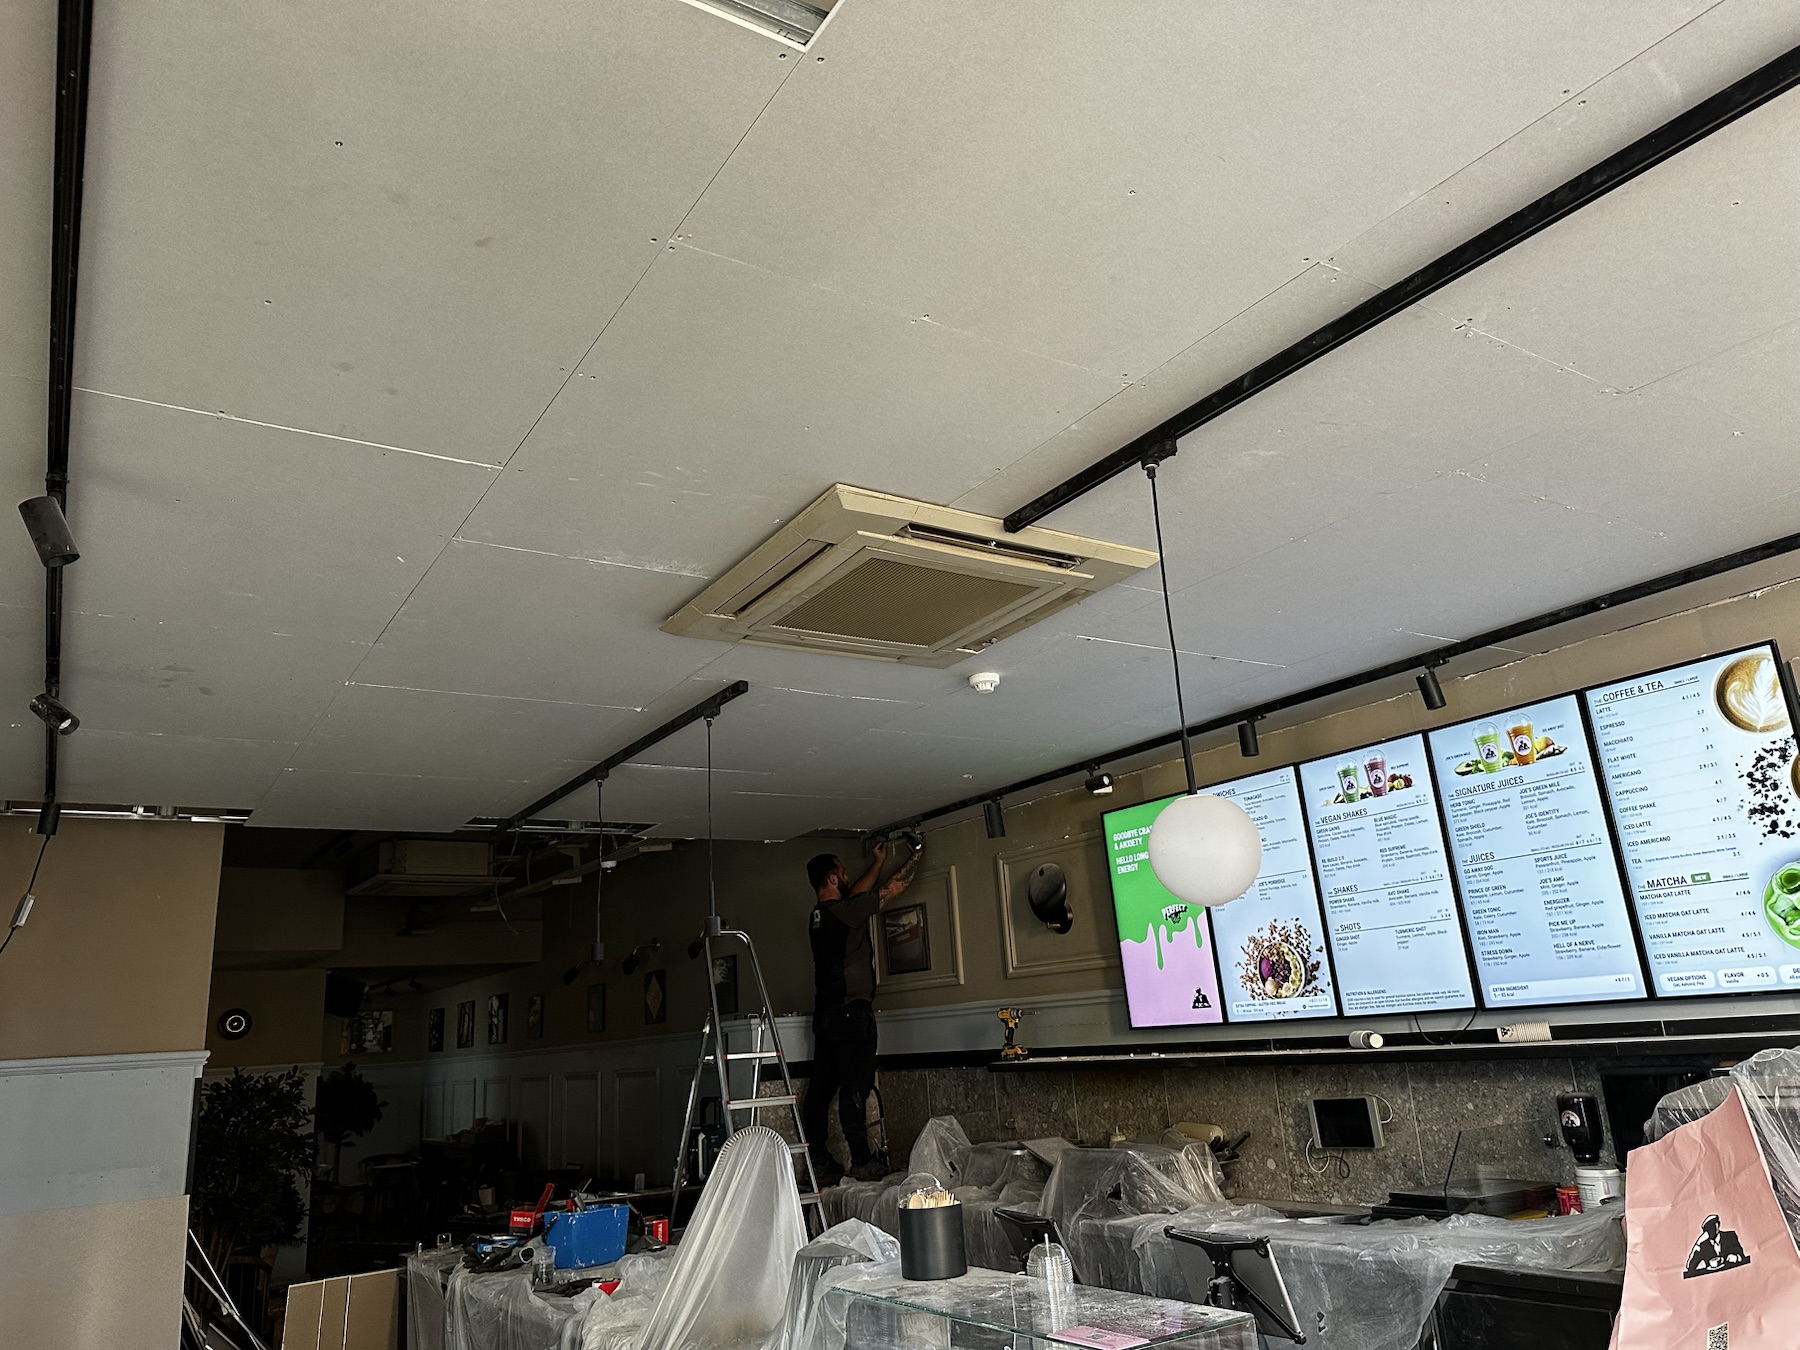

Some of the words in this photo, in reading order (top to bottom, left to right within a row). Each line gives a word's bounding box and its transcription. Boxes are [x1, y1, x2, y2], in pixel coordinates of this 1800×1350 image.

[1603, 687, 1636, 702] COFFEE
[1638, 685, 1644, 693] &
[1645, 681, 1664, 692] TEA
[1596, 707, 1611, 715] LATTE
[1600, 721, 1625, 731] ESPRESSO
[1604, 736, 1633, 747] MACCHIATO
[1612, 770, 1641, 780] AMERICANO
[1455, 780, 1496, 797] SIGNATURE
[1498, 775, 1524, 787] JUICES
[1615, 786, 1648, 796] CAPPUCCINO
[1539, 808, 1559, 817] IDENTITY
[1619, 805, 1638, 814] COFFEE
[1320, 814, 1341, 824] VEGAN
[1342, 808, 1368, 819] SHAKES
[1113, 828, 1138, 841] GOODBYE
[1120, 837, 1142, 850] ANXIETY
[1640, 836, 1671, 845] AMERICANO
[1116, 854, 1133, 865] HELLO
[1134, 851, 1149, 862] LONG
[1469, 852, 1495, 863] JUICES
[1118, 863, 1138, 874] ENERGY
[1647, 876, 1687, 889] MATCHA
[1333, 884, 1358, 895] SHAKES
[1340, 922, 1361, 932] SHOTS
[1667, 951, 1690, 959] VANILLA
